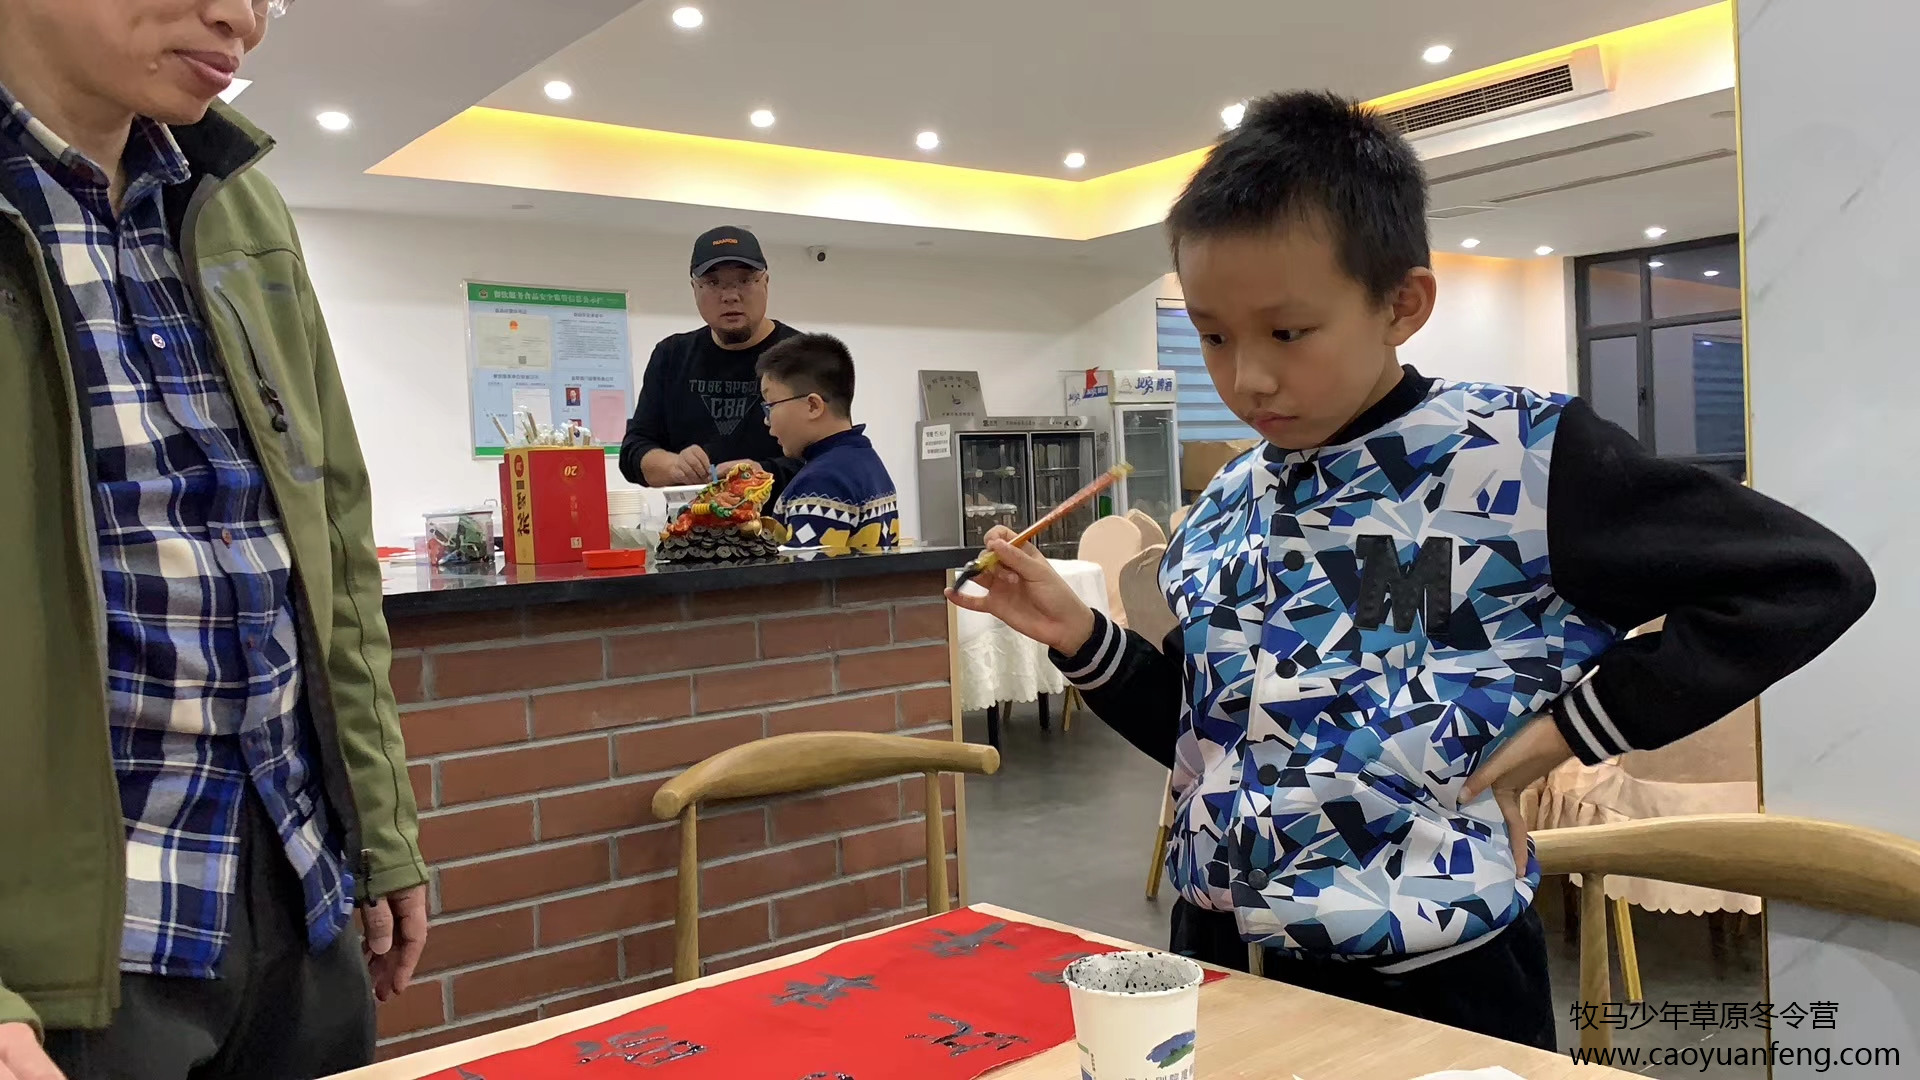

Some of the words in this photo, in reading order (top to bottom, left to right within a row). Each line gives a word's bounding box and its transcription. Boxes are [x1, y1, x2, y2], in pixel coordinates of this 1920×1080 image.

[711, 397, 747, 419] CBA
[564, 466, 578, 476] 20
[1354, 534, 1453, 636] M
